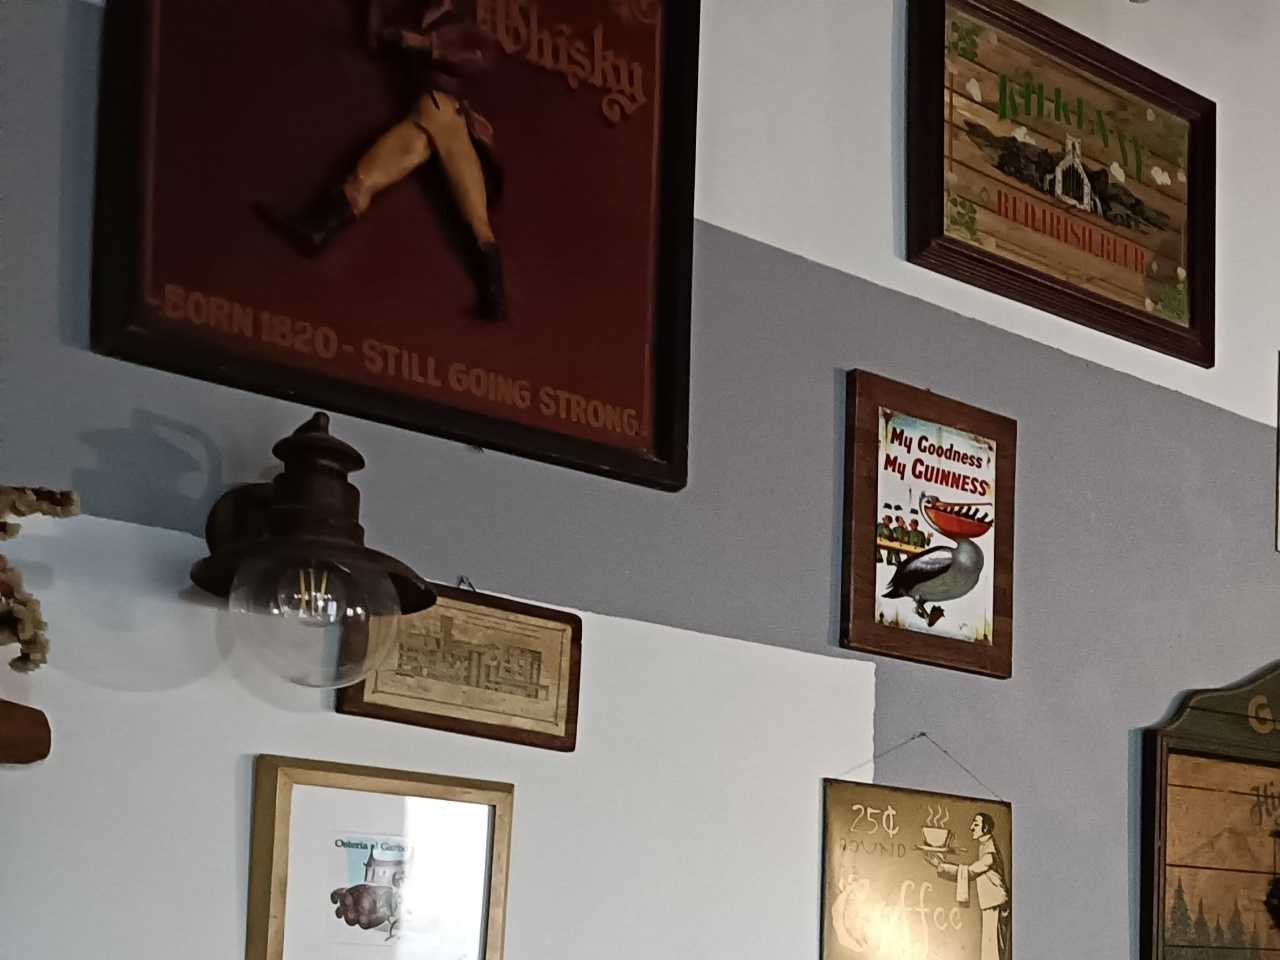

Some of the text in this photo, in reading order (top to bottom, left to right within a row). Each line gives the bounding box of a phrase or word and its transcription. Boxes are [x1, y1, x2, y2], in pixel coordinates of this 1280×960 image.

[163, 283, 253, 337] BORN
[259, 311, 338, 360] 1820
[362, 337, 443, 387] STILL
[448, 363, 531, 409] GOING
[890, 427, 983, 469] My Goodness
[884, 453, 989, 497] My GUINNESS
[335, 838, 368, 850] Osteria
